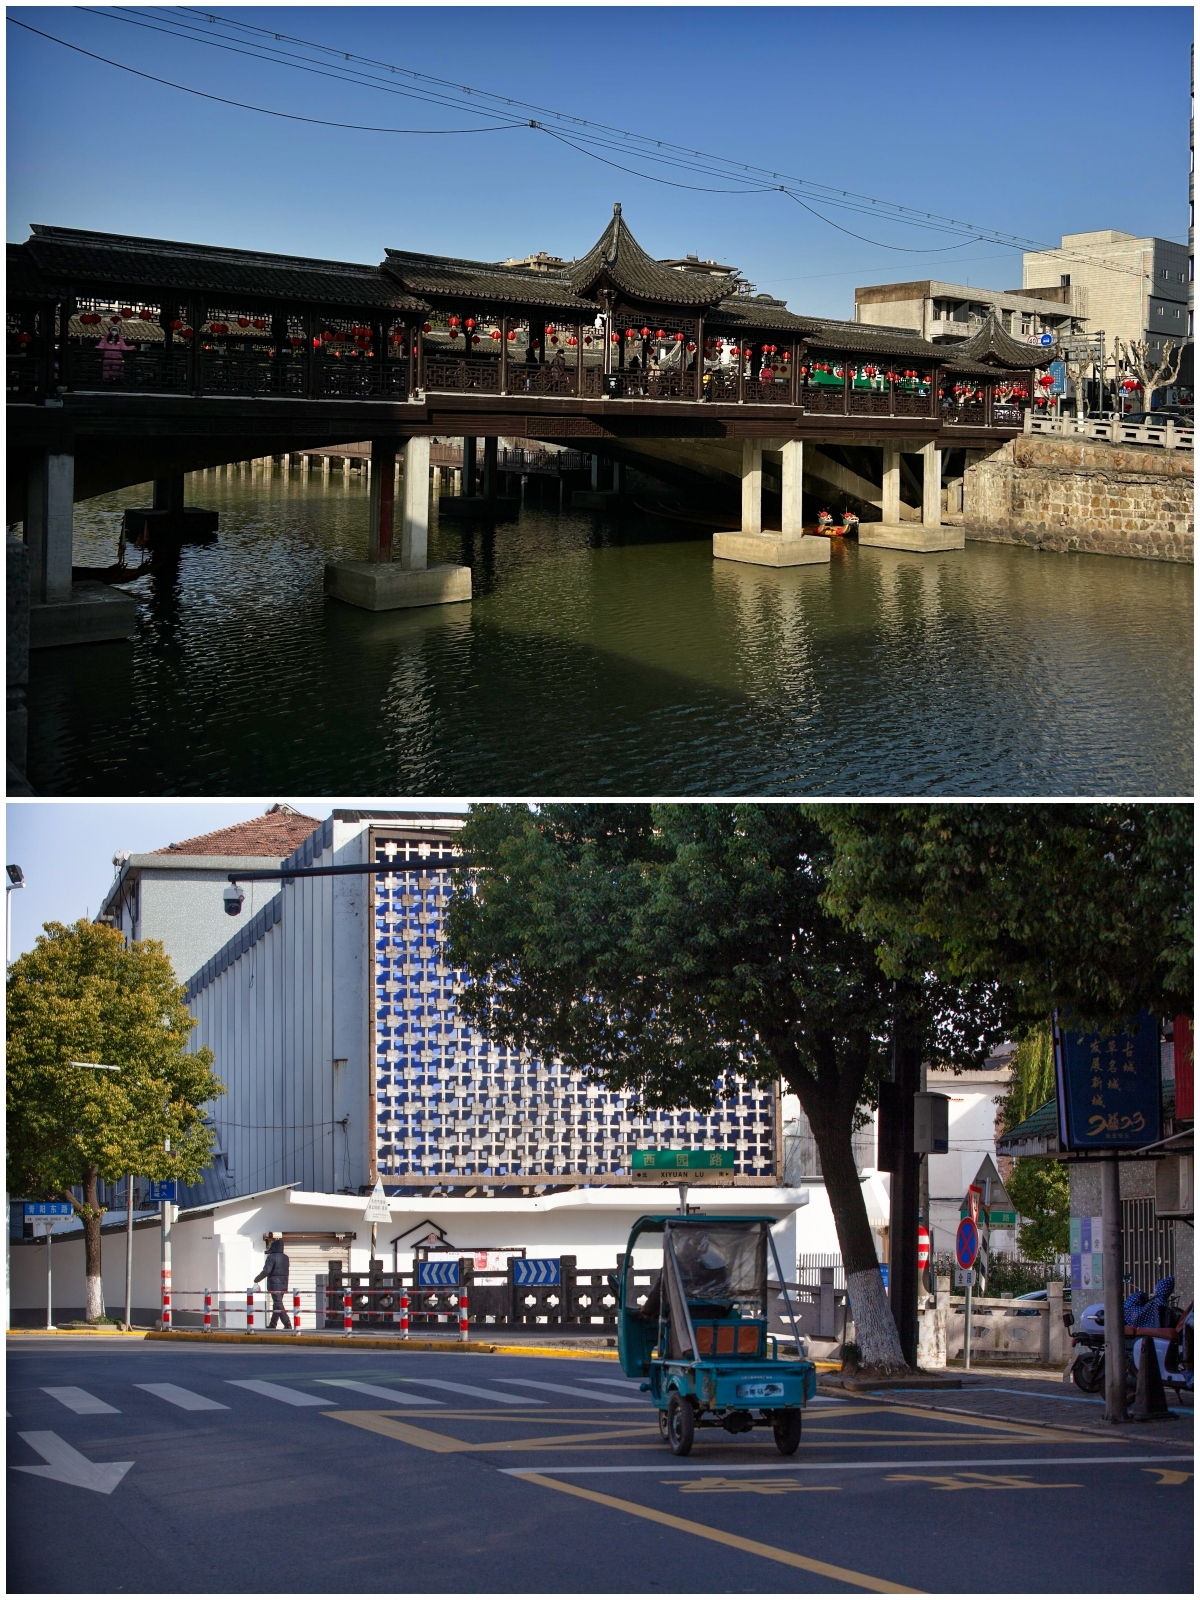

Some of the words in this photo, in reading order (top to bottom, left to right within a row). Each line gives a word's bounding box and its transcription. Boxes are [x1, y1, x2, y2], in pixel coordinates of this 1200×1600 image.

[643, 1153, 723, 1167] 西园路
[28, 1204, 68, 1214] 青阳东路
